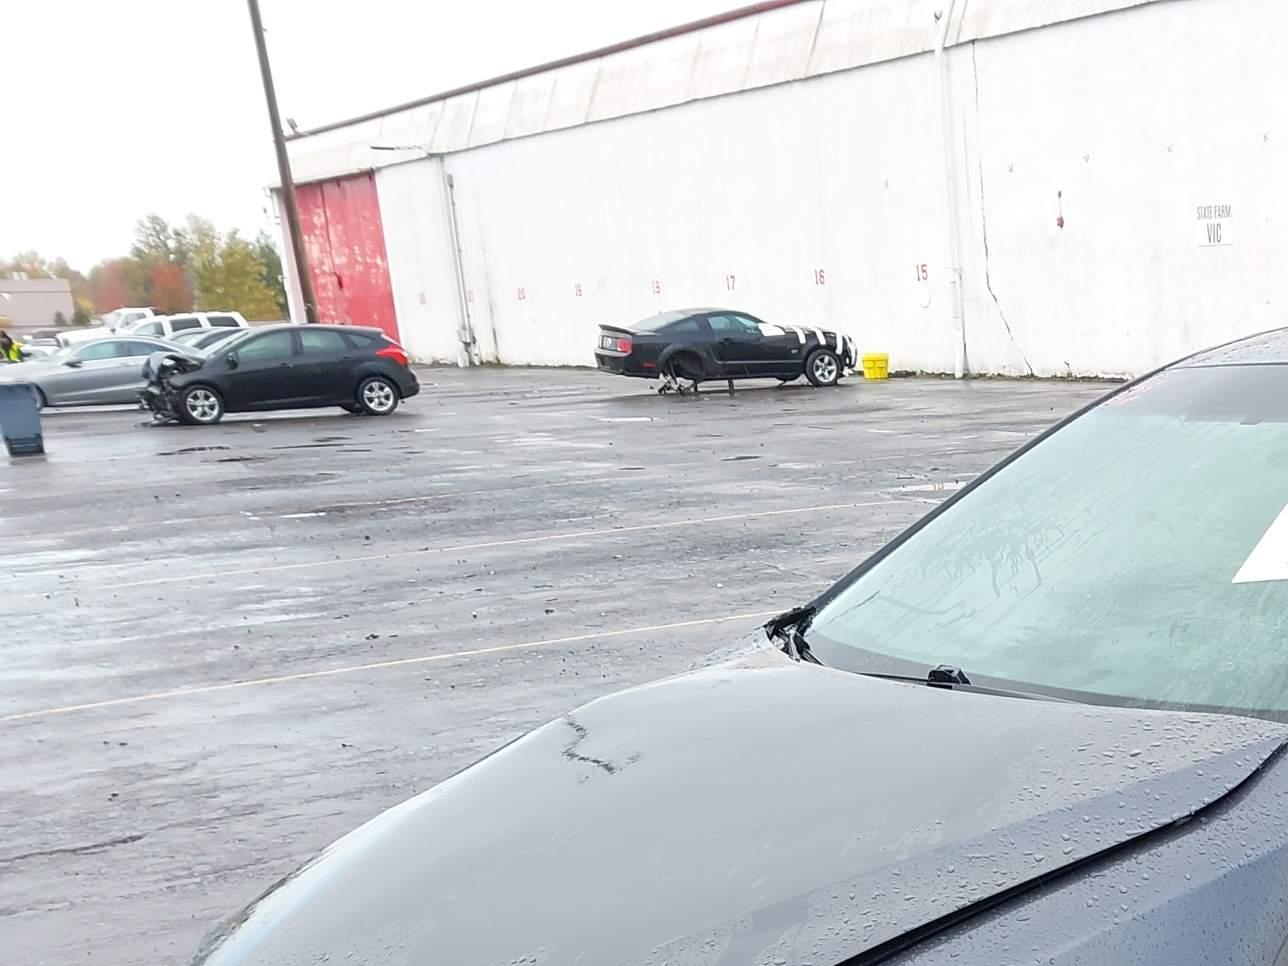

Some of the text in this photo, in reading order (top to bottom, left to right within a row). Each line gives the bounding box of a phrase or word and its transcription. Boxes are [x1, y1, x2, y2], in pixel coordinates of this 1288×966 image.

[1196, 205, 1213, 220] STATE
[1206, 222, 1222, 244] VIC
[915, 263, 929, 282] 15
